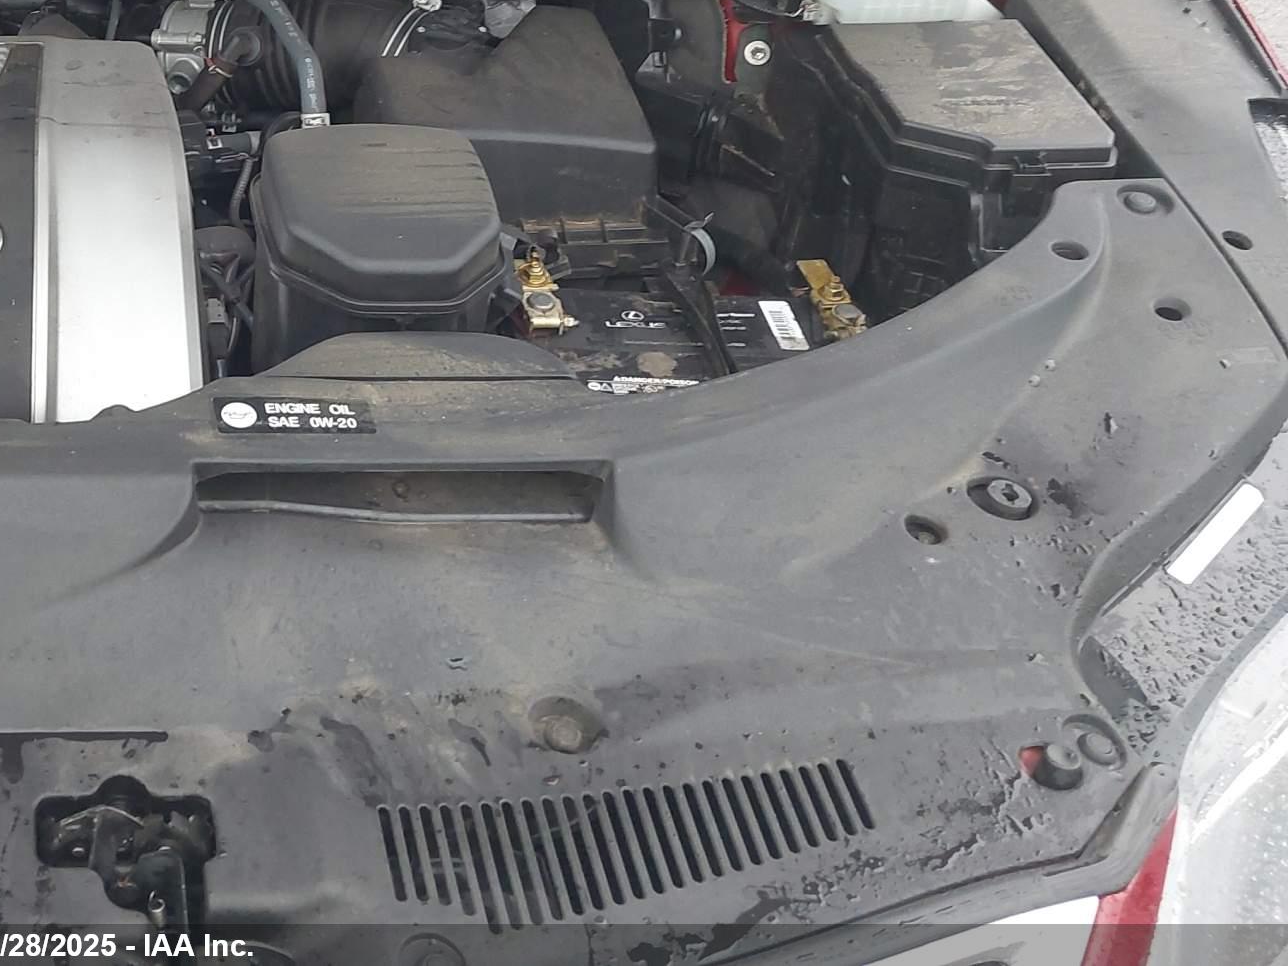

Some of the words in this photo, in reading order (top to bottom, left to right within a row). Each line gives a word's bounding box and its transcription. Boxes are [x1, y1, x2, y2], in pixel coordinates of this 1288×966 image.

[264, 402, 321, 415] ENGINE
[328, 404, 356, 416] OIL
[267, 416, 301, 428] SAE
[309, 417, 358, 429] 0W-20
